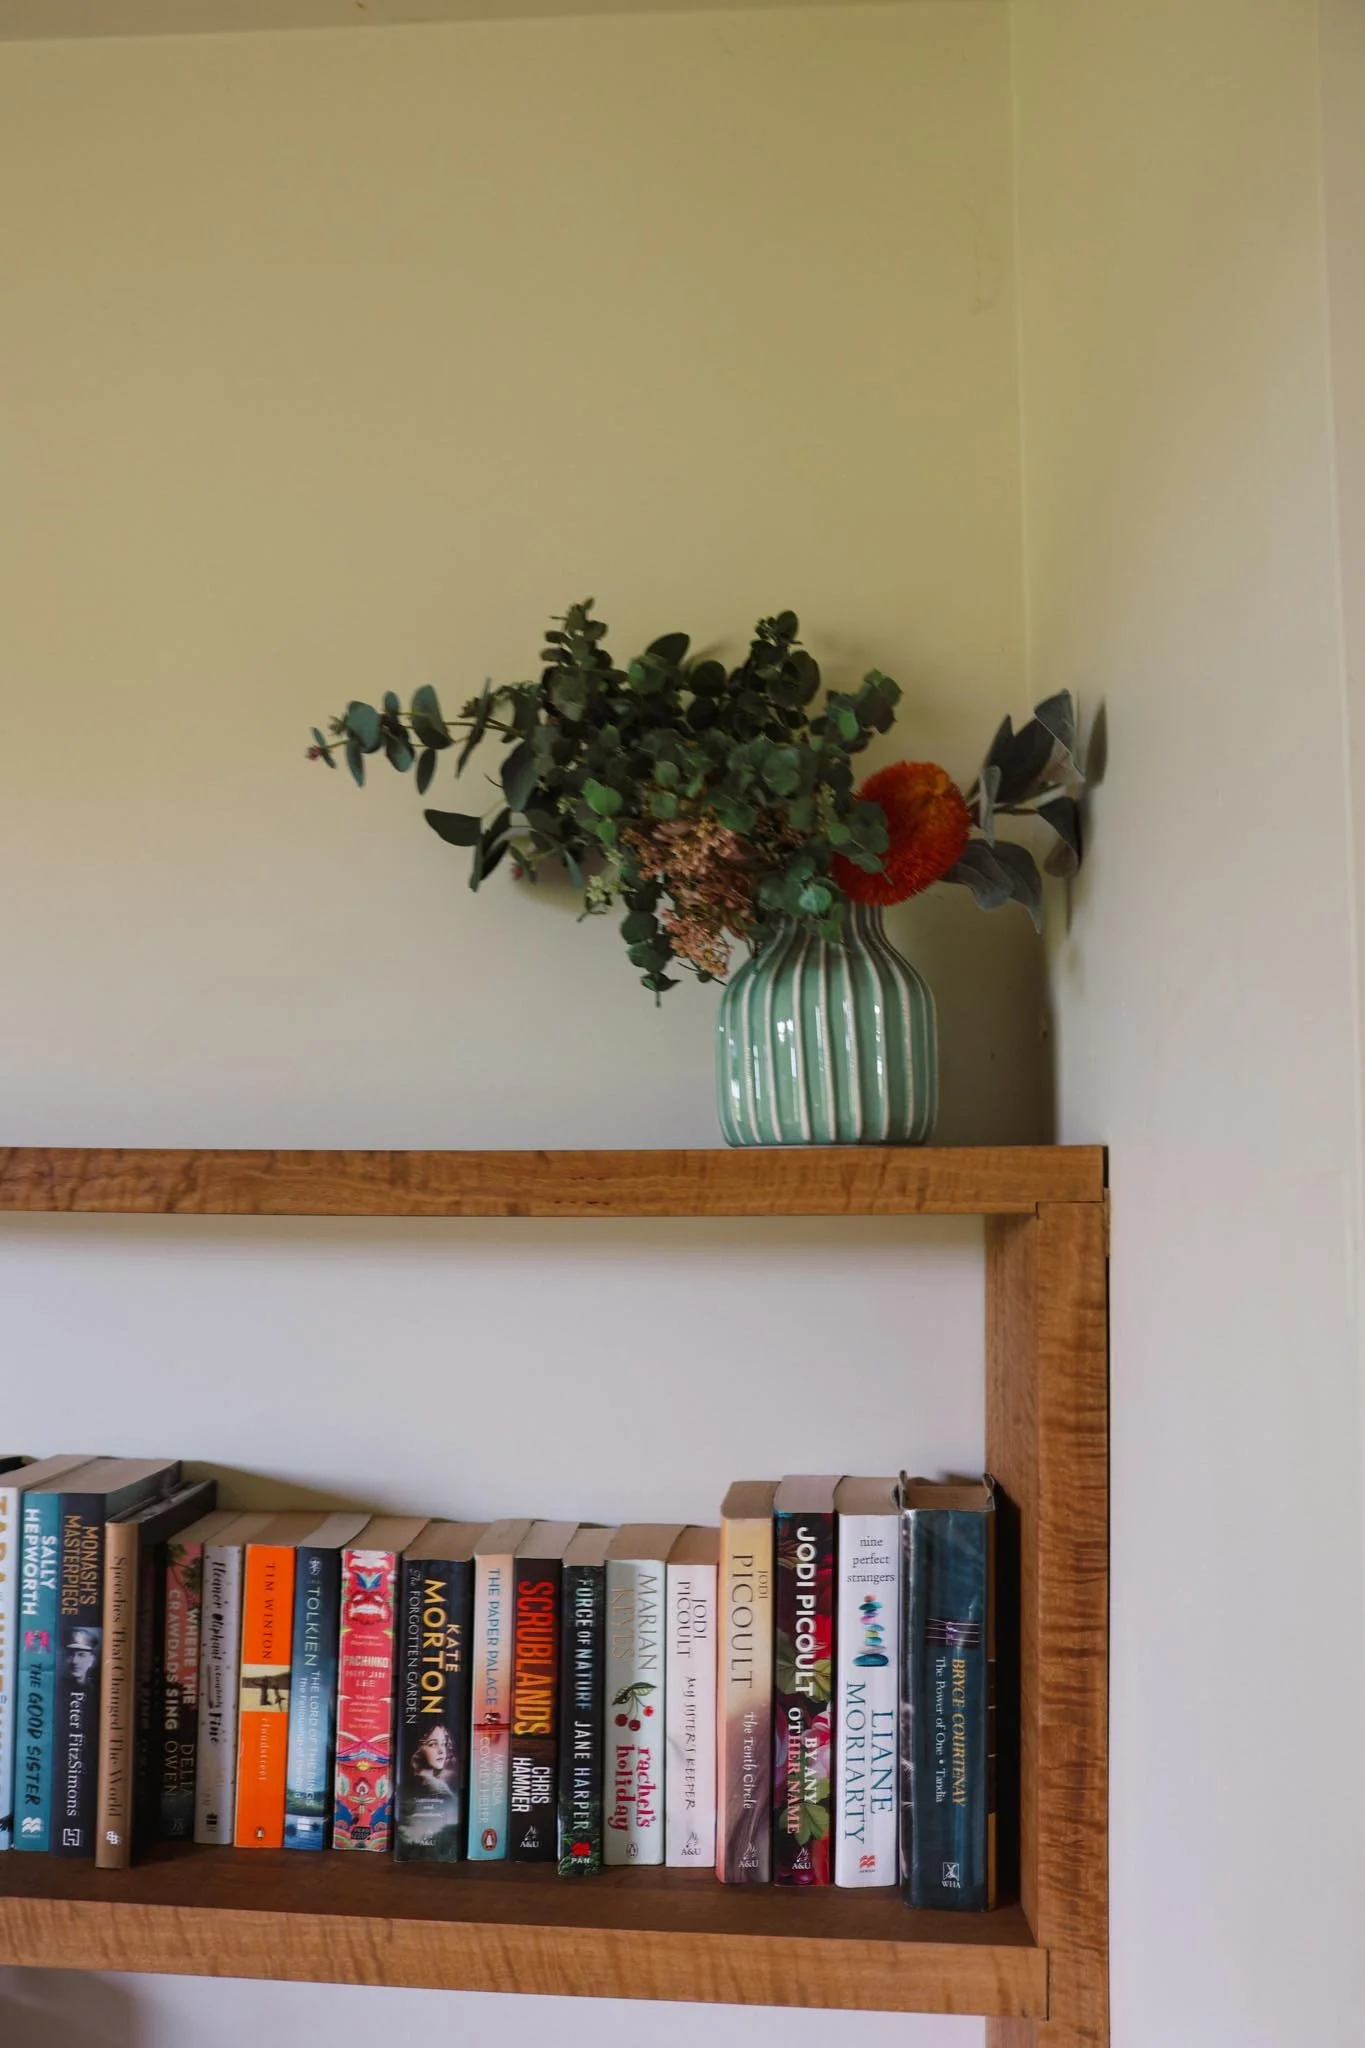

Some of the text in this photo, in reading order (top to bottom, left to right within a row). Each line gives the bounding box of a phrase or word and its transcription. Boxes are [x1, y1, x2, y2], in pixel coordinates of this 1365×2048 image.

[22, 1508, 41, 1615] HEPWORTH
[40, 1535, 57, 1590] SALLY
[61, 1515, 82, 1615] MASTERPIECE
[79, 1526, 99, 1605] MONASH'S
[847, 1572, 896, 1584] strangers
[852, 1553, 890, 1568] perfect
[859, 1536, 884, 1547] nine
[262, 1563, 277, 1659] TIM WINTON
[638, 1573, 657, 1670] MARIAN
[677, 1581, 692, 1658] PICOULT
[692, 1599, 707, 1639] JODI
[731, 1554, 754, 1688] PICOULT
[757, 1570, 769, 1599] JODI
[795, 1526, 817, 1697] JODI PICOULT
[164, 1588, 181, 1730] CRAWDADS SING
[183, 1608, 199, 1704] WHERE THE
[303, 1587, 320, 1666] TOLKIEN
[344, 1655, 389, 1668] PACHINKO
[407, 1591, 421, 1667] FORGOTTEN
[420, 1579, 448, 1713] MORTON
[445, 1624, 461, 1672] KATE
[486, 1568, 501, 1706] THE PAPER PALACE
[513, 1579, 554, 1736] SCRUBLANDS
[574, 1579, 594, 1710] FORCE OF NATURE
[107, 1556, 127, 1816] Speeches That Changed The World
[309, 1695, 320, 1725] LORD
[311, 1671, 320, 1692] THE
[405, 1671, 420, 1724] GARDEN
[25, 1662, 44, 1805] THE GOOD SISTER
[66, 1692, 85, 1817] Peter FitzSimons
[208, 1712, 223, 1744] Fine
[743, 1712, 760, 1809] The Tenth Circle
[844, 1681, 866, 1844] MORIARTY
[870, 1709, 894, 1815] LIANE
[935, 1656, 947, 1804] The Power of One Tandia
[951, 1658, 967, 1808] BRYCE COURTENAY
[180, 1743, 194, 1798] DELIA
[511, 1757, 532, 1812] HAMMER
[530, 1766, 551, 1804] CHRIS
[572, 1721, 592, 1830] JANE HARPER
[608, 1744, 636, 1831] holiday
[636, 1748, 656, 1828] rachel's
[684, 1758, 696, 1810] KEEPER
[786, 1707, 802, 1834] OTHER NAME
[804, 1736, 818, 1804] BY ANY
[681, 1848, 701, 1856] A&U
[792, 1862, 812, 1870] A&U
[942, 1881, 961, 1889] WHA
